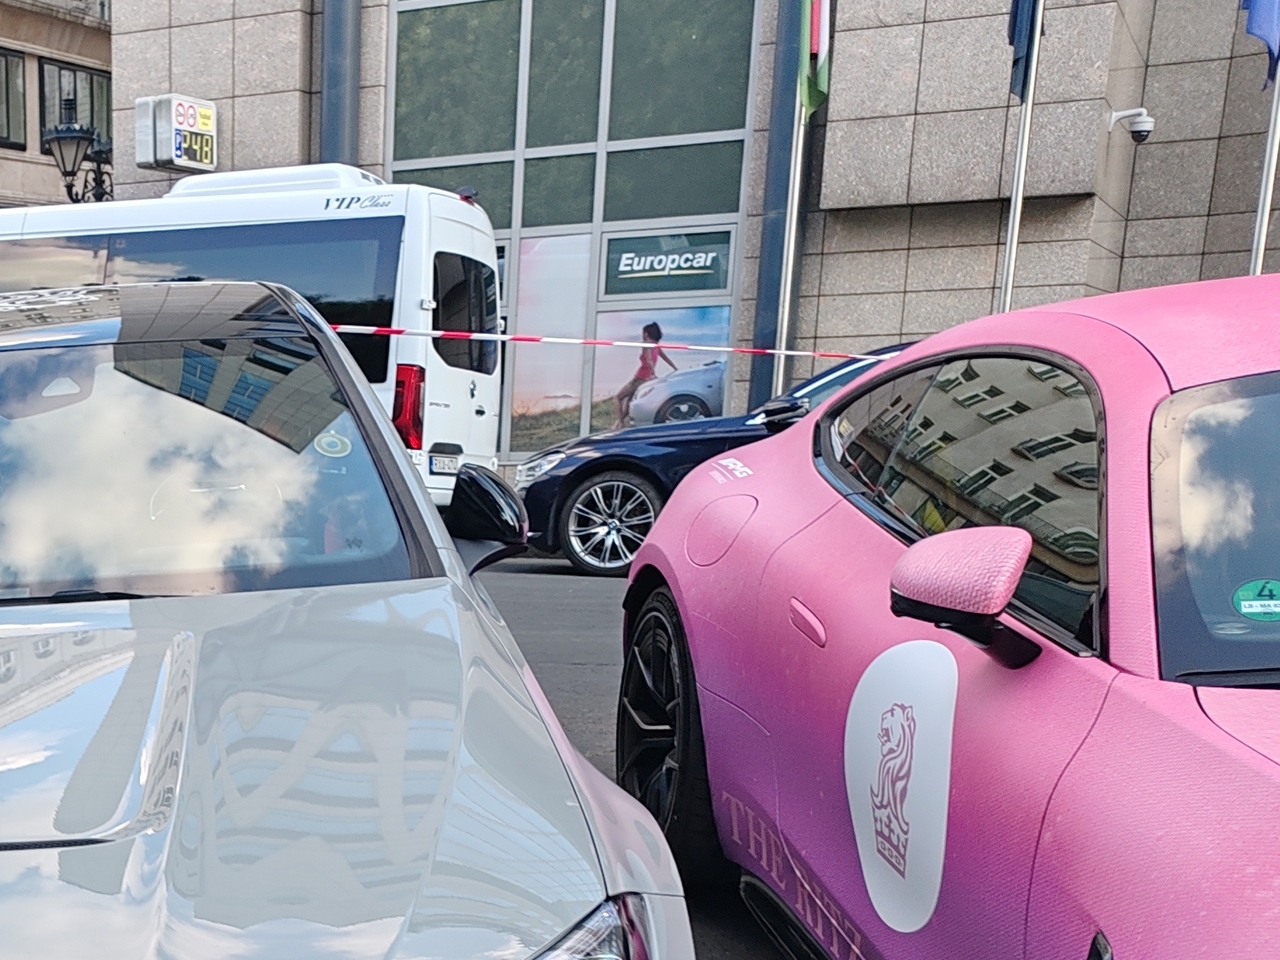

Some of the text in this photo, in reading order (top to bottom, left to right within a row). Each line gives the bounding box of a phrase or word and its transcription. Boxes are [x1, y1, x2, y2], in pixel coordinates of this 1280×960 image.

[323, 194, 391, 211] VIP Class
[618, 252, 717, 275] Europcar
[1257, 581, 1276, 600] 4
[722, 791, 787, 891] THE
